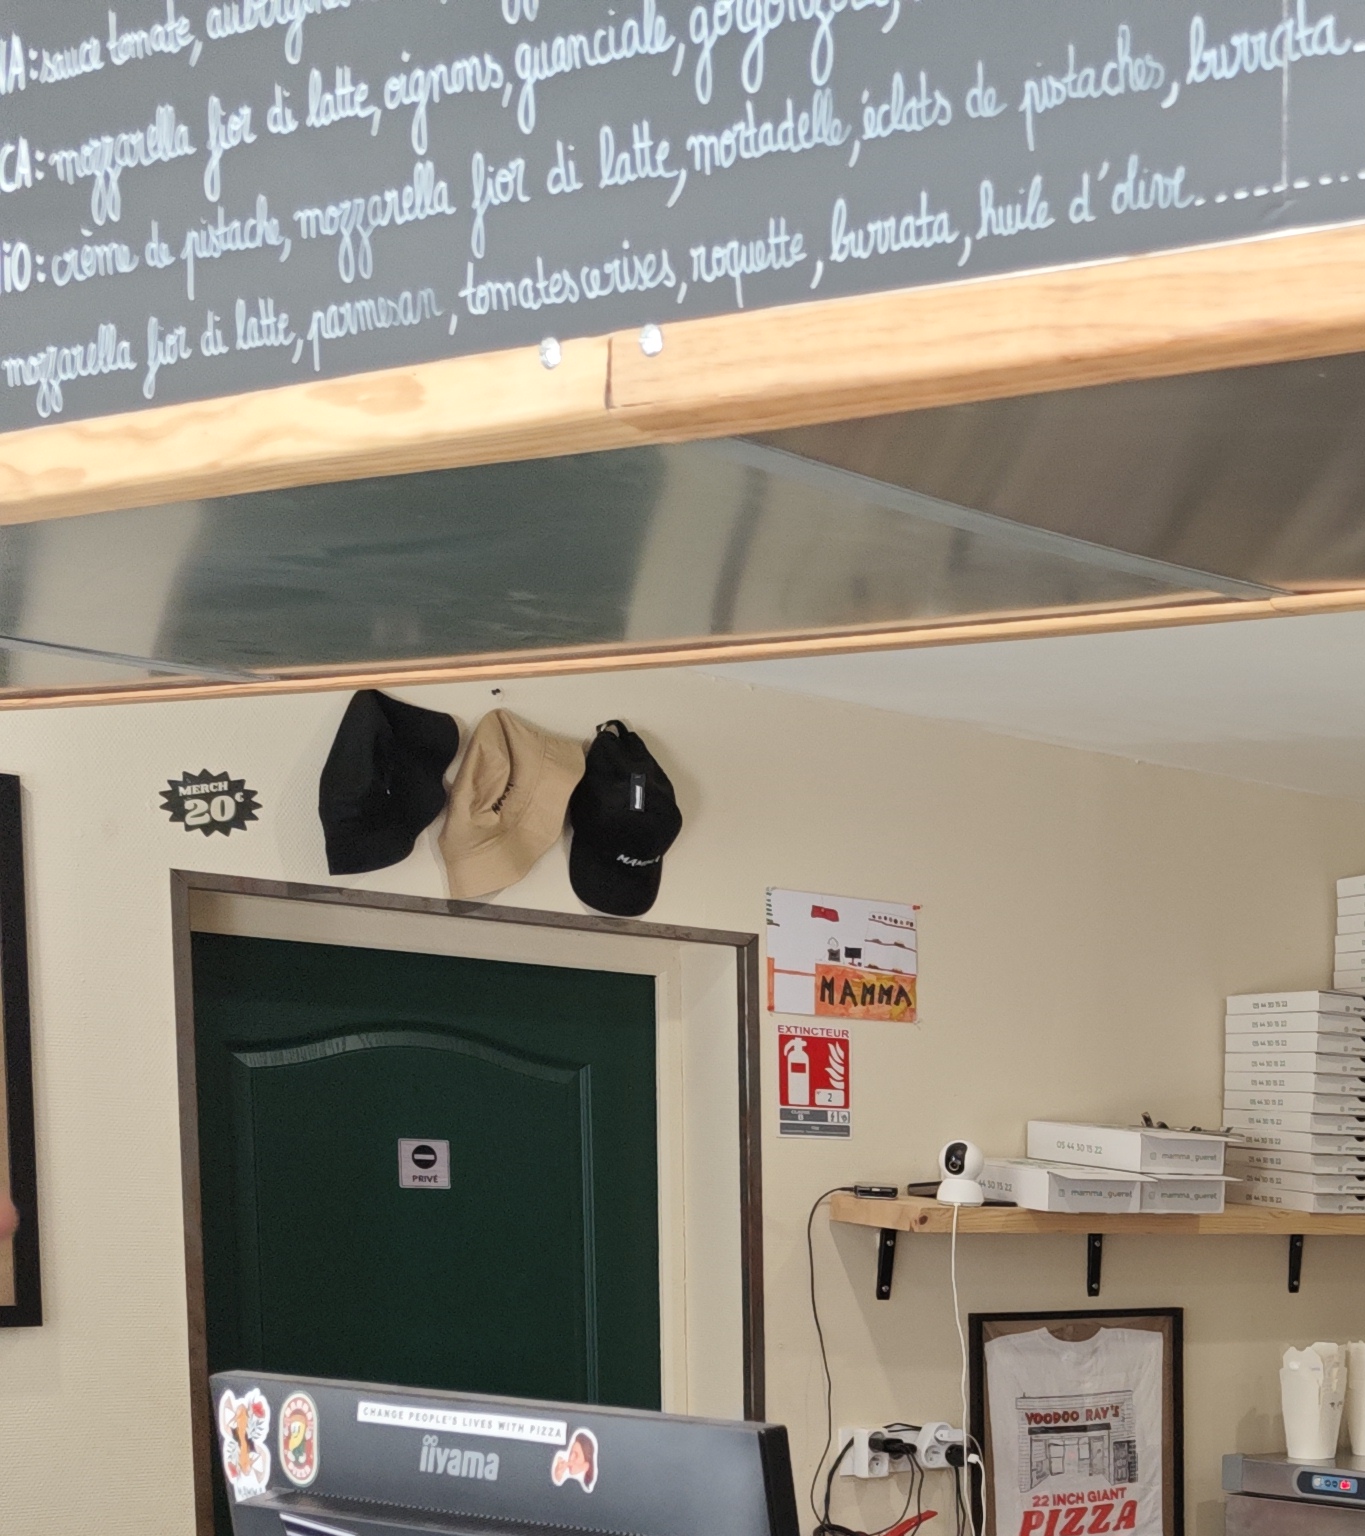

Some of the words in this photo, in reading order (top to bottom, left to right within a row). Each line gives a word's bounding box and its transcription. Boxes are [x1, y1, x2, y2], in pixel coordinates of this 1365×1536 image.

[40, 36, 104, 83] sauce
[106, 0, 203, 67] tomate,
[49, 103, 197, 226] mozzarella
[203, 95, 257, 202] fior
[267, 82, 299, 134] di
[305, 65, 382, 136] latte,
[384, 50, 512, 155] oignons,
[514, 0, 687, 134] guanciale,
[52, 226, 139, 286] crème
[145, 220, 175, 269] de
[181, 194, 292, 300] pistache,
[293, 160, 456, 283] mozzarella
[471, 151, 531, 259] fior
[546, 139, 583, 194] di
[599, 119, 687, 208] latte,
[965, 60, 1006, 119] de
[2, 323, 137, 418] mozzarella
[142, 316, 192, 399] fior
[200, 309, 229, 357] di
[235, 296, 303, 364] latte,
[977, 173, 1056, 240] huile
[178, 781, 229, 796] MERCH
[184, 792, 245, 826] 20€
[820, 975, 912, 1008] MAMMA
[777, 1025, 850, 1038] EXTINCTEUR
[827, 1092, 834, 1103] 2
[412, 1174, 439, 1183] PRIVÉ
[363, 1406, 404, 1420] CHANGE
[409, 1412, 458, 1427] PEOPLE'S
[463, 1419, 493, 1430] LIVES
[498, 1422, 526, 1434] WITH
[530, 1426, 562, 1439] PIZZA
[1025, 1411, 1079, 1425] VOODOO
[1085, 1405, 1120, 1421] RAY'S
[419, 1434, 500, 1481] iiyama
[1032, 1495, 1049, 1507] 22
[1052, 1492, 1084, 1506] INCH
[1087, 1487, 1127, 1503] GIANT
